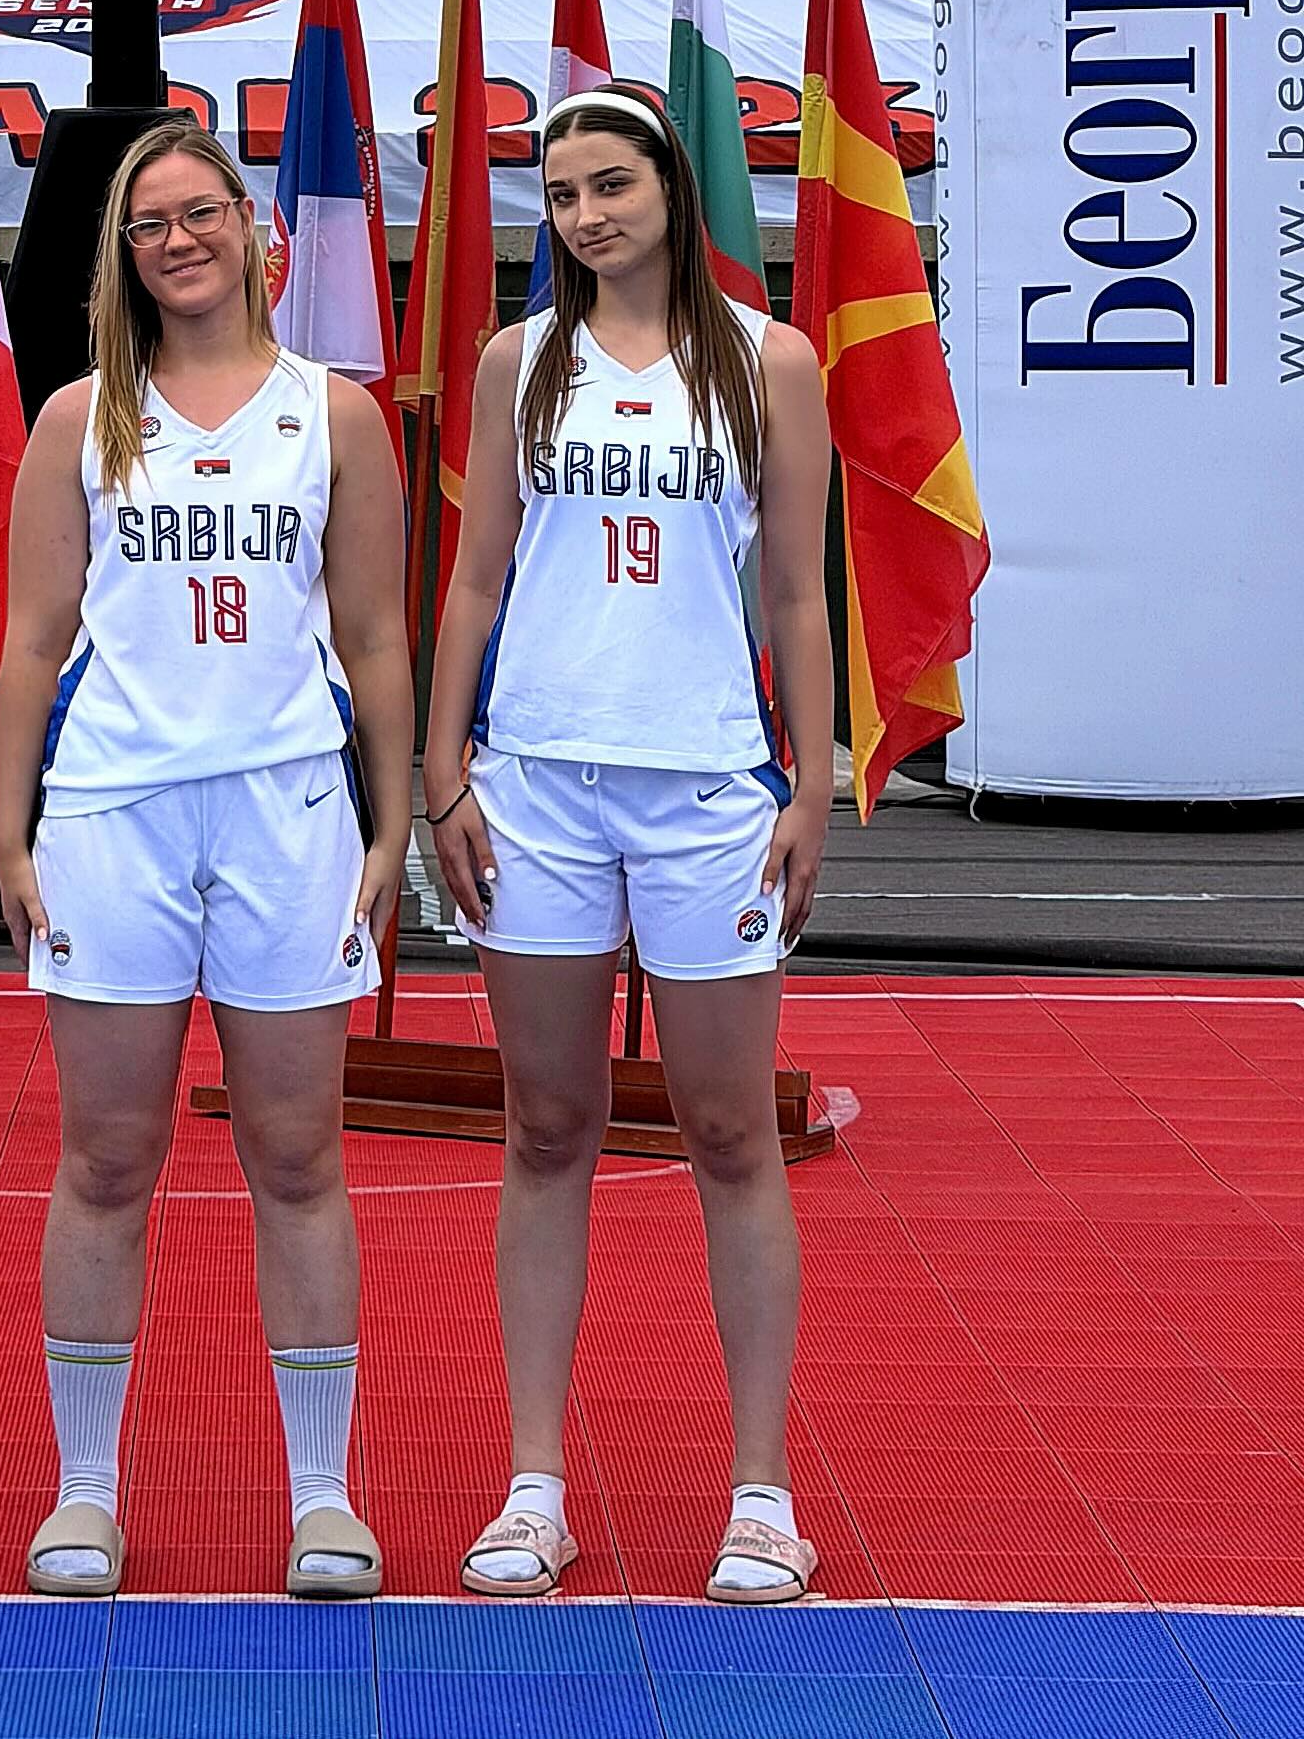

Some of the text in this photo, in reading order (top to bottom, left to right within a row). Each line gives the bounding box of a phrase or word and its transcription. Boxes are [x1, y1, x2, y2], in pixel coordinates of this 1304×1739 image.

[532, 441, 725, 504] SRBIJA
[118, 503, 302, 564] SRBIJA
[602, 515, 660, 584] 19
[187, 575, 247, 644] 18
